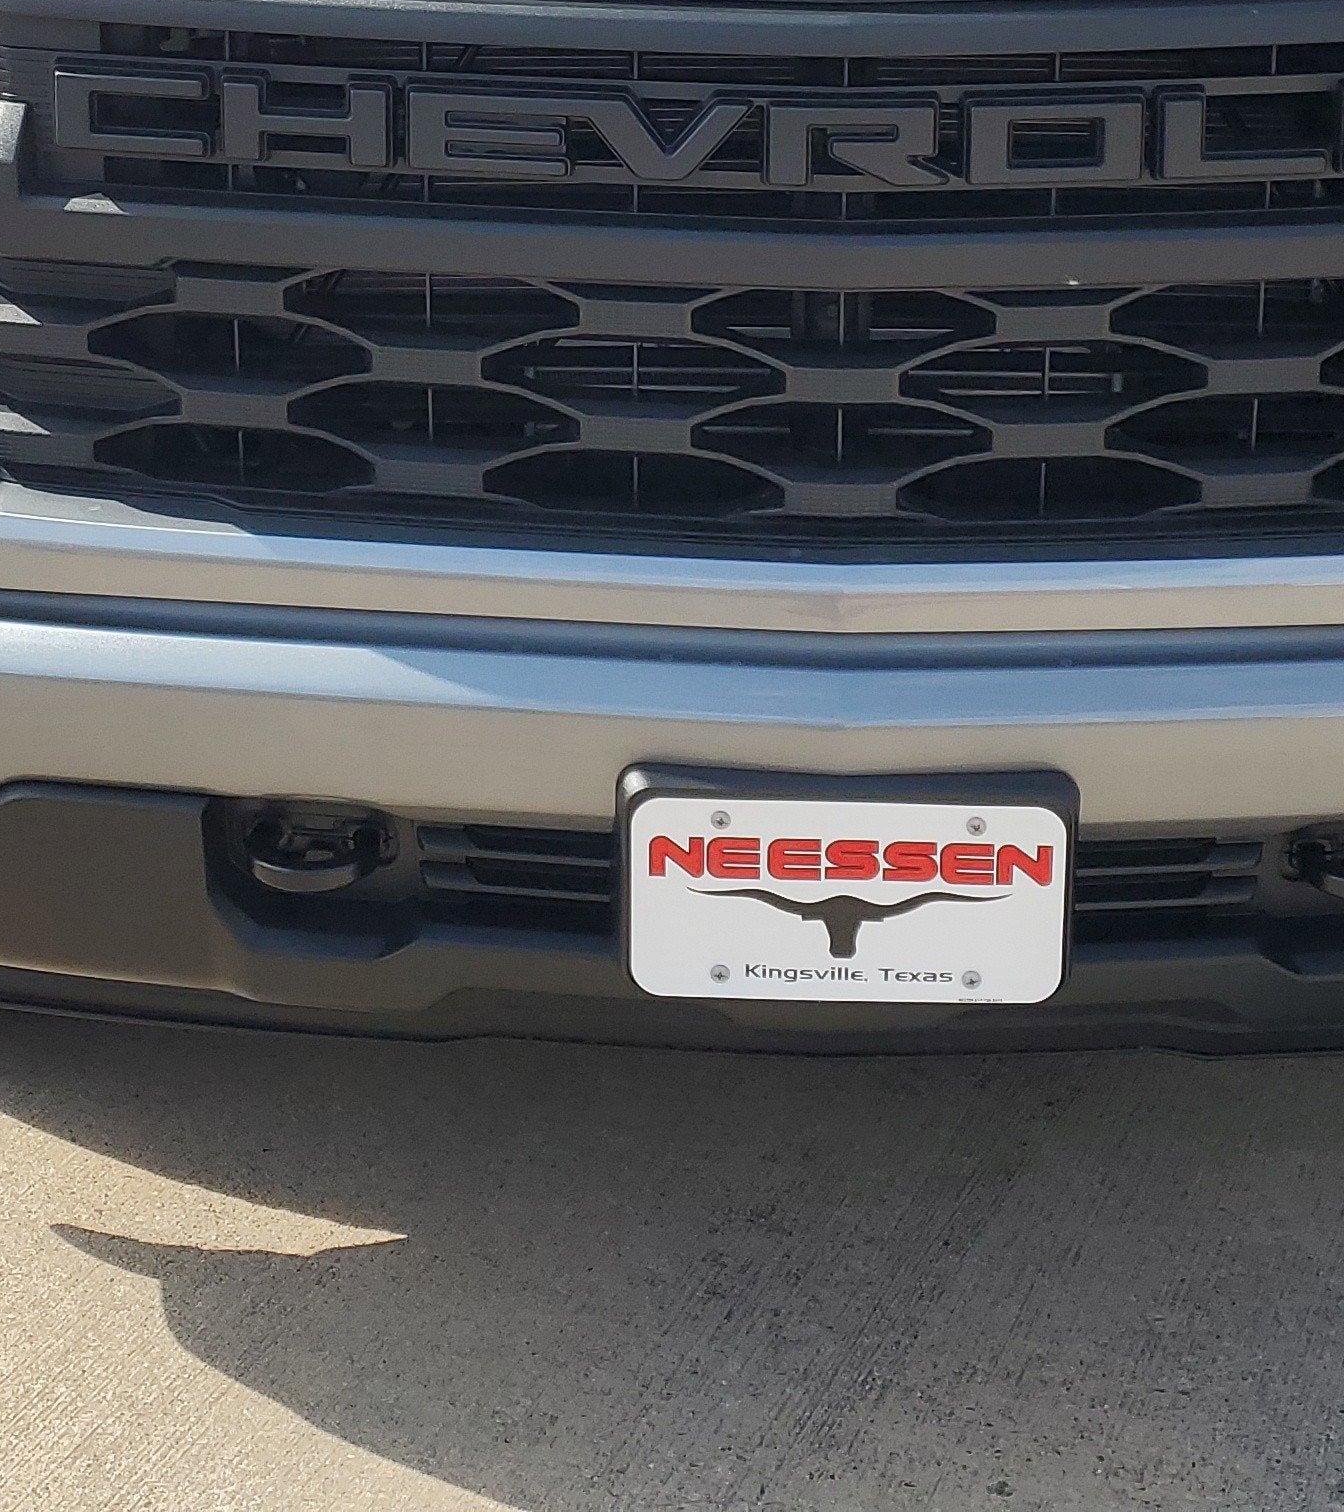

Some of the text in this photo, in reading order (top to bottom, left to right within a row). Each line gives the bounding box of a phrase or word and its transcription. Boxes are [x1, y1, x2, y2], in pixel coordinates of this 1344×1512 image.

[648, 834, 1054, 887] NEESSEN
[744, 963, 954, 984] Kingsville, Texas
